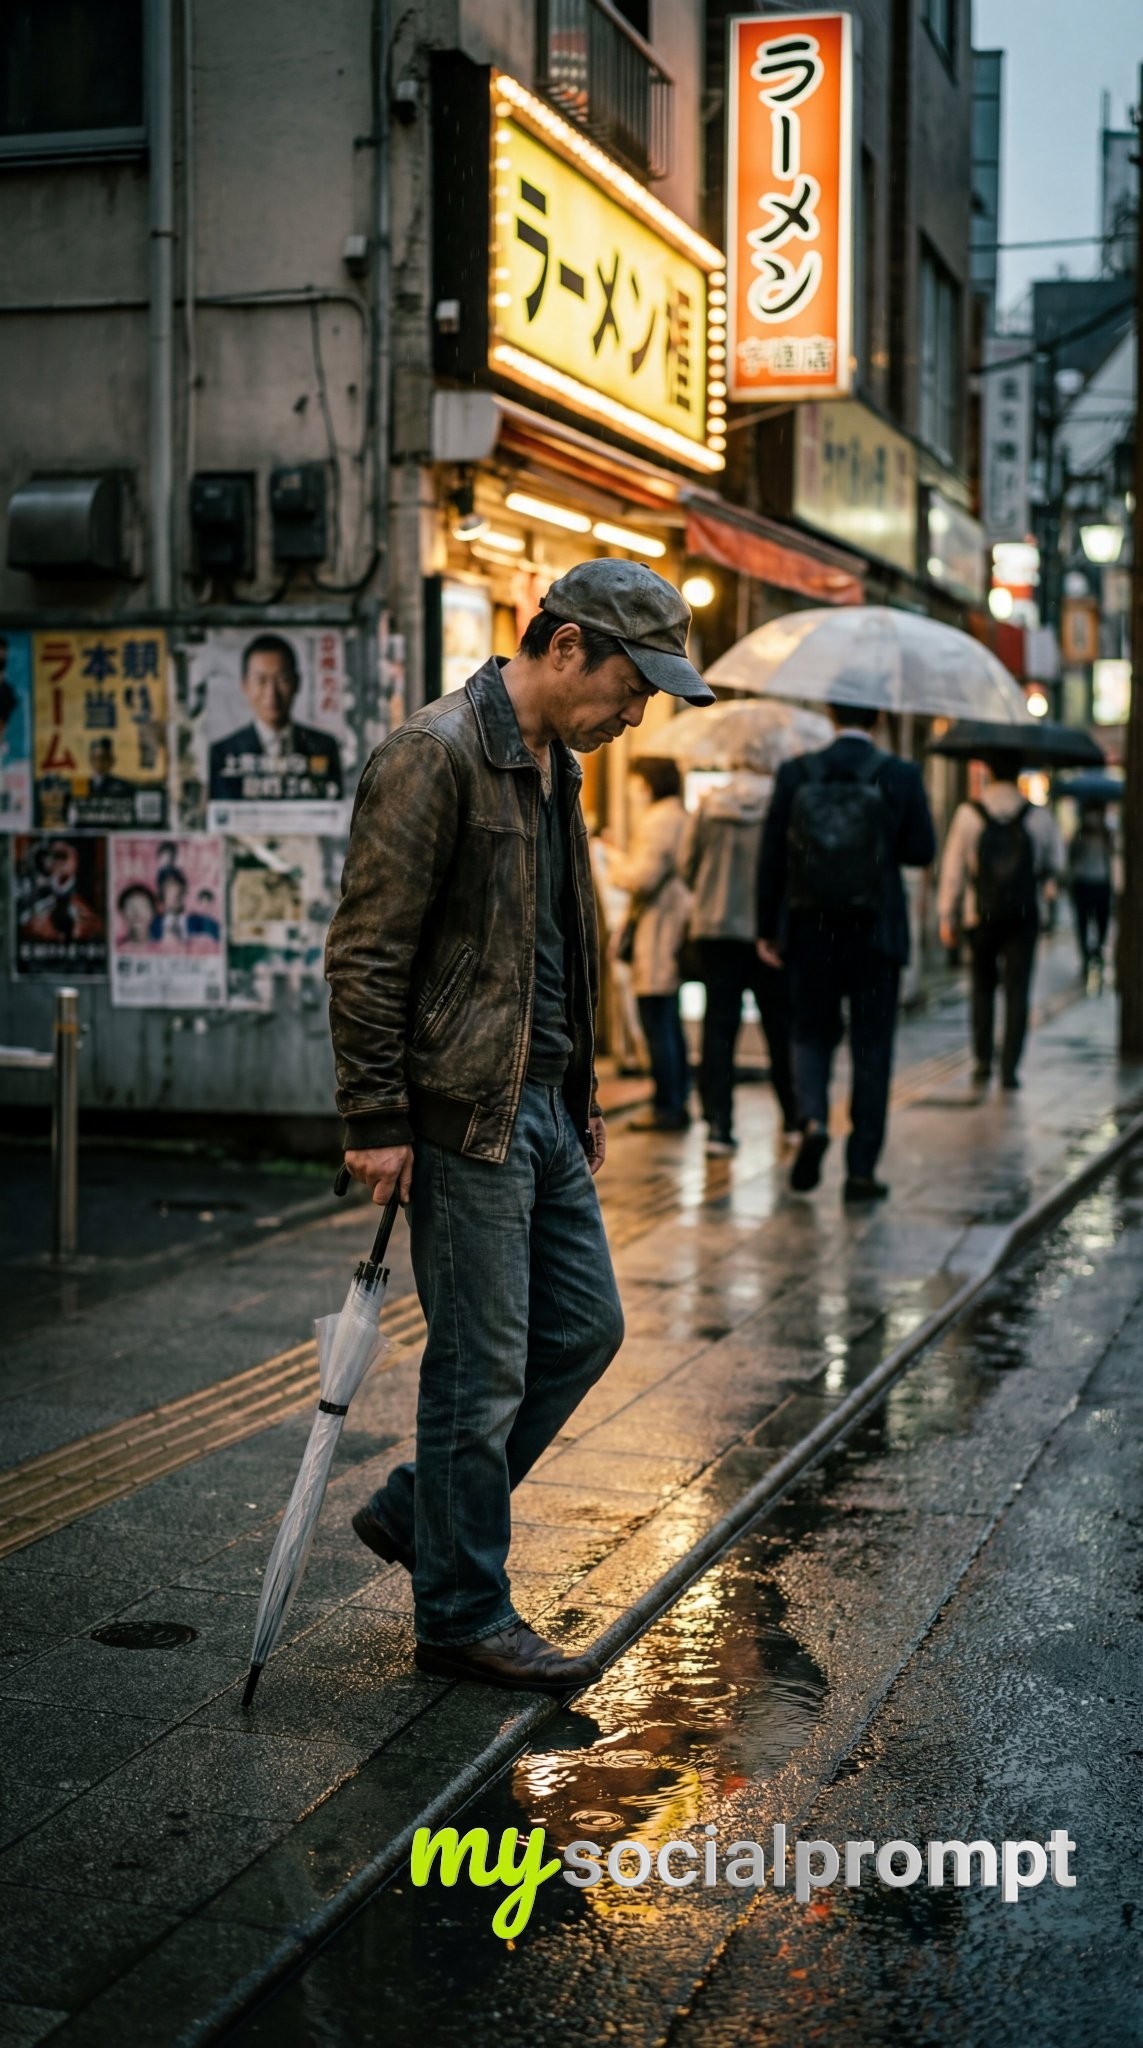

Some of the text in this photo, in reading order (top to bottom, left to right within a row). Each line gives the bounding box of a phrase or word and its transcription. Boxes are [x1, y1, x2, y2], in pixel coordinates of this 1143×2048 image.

[757, 39, 818, 316] ラーメン
[41, 641, 77, 771] ラーム
[82, 640, 118, 730] 本当
